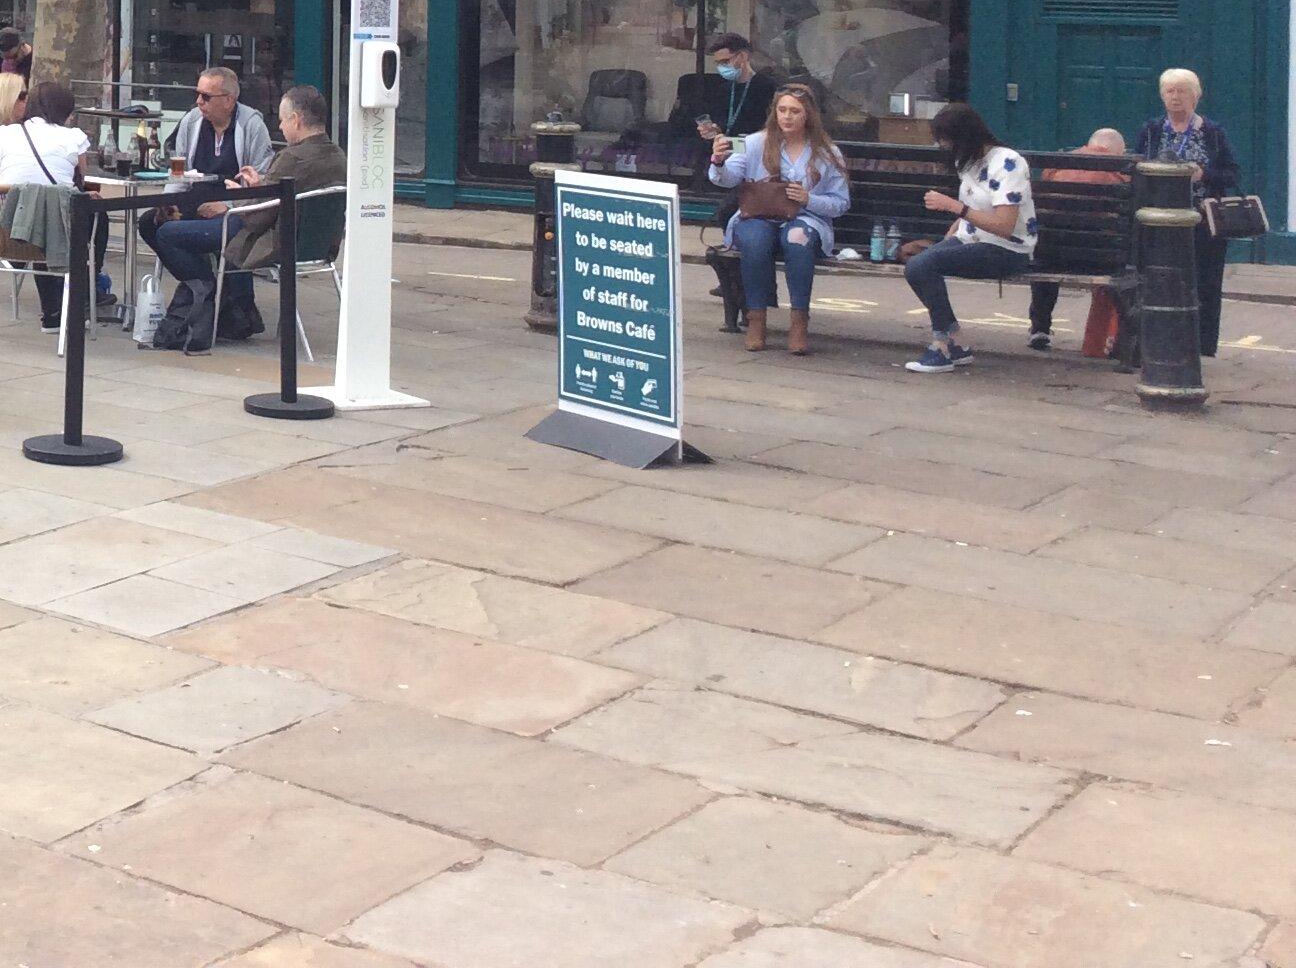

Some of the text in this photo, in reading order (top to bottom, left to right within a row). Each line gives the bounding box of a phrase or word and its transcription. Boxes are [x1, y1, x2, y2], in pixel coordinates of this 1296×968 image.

[562, 202, 666, 231] Please wait here
[575, 231, 653, 257] to be seated
[575, 257, 655, 285] by a member
[582, 286, 648, 311] of staff for
[576, 311, 656, 341] Browns Café
[583, 348, 649, 372] WHAT WE ASK OF YOU
